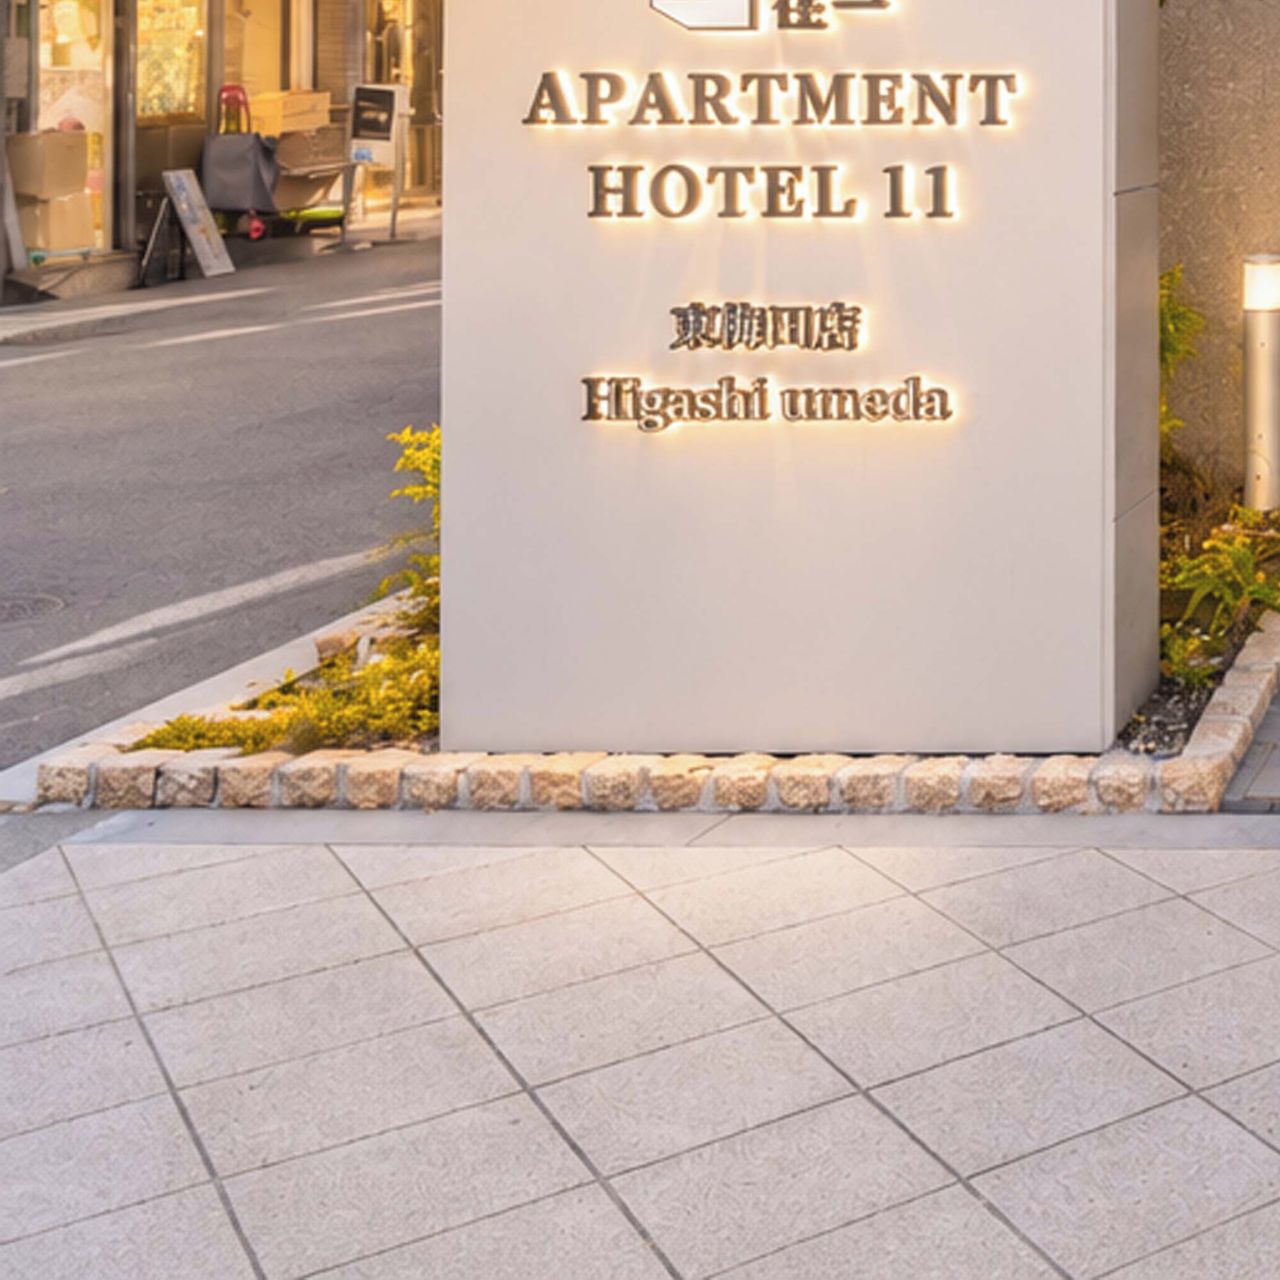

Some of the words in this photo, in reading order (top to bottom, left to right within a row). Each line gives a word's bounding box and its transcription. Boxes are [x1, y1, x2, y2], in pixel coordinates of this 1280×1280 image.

[522, 71, 1018, 126] APARTMENT
[586, 164, 858, 219] HOTEL
[882, 164, 955, 219] 11
[581, 376, 770, 433] Higashi
[780, 376, 954, 422] umeda
